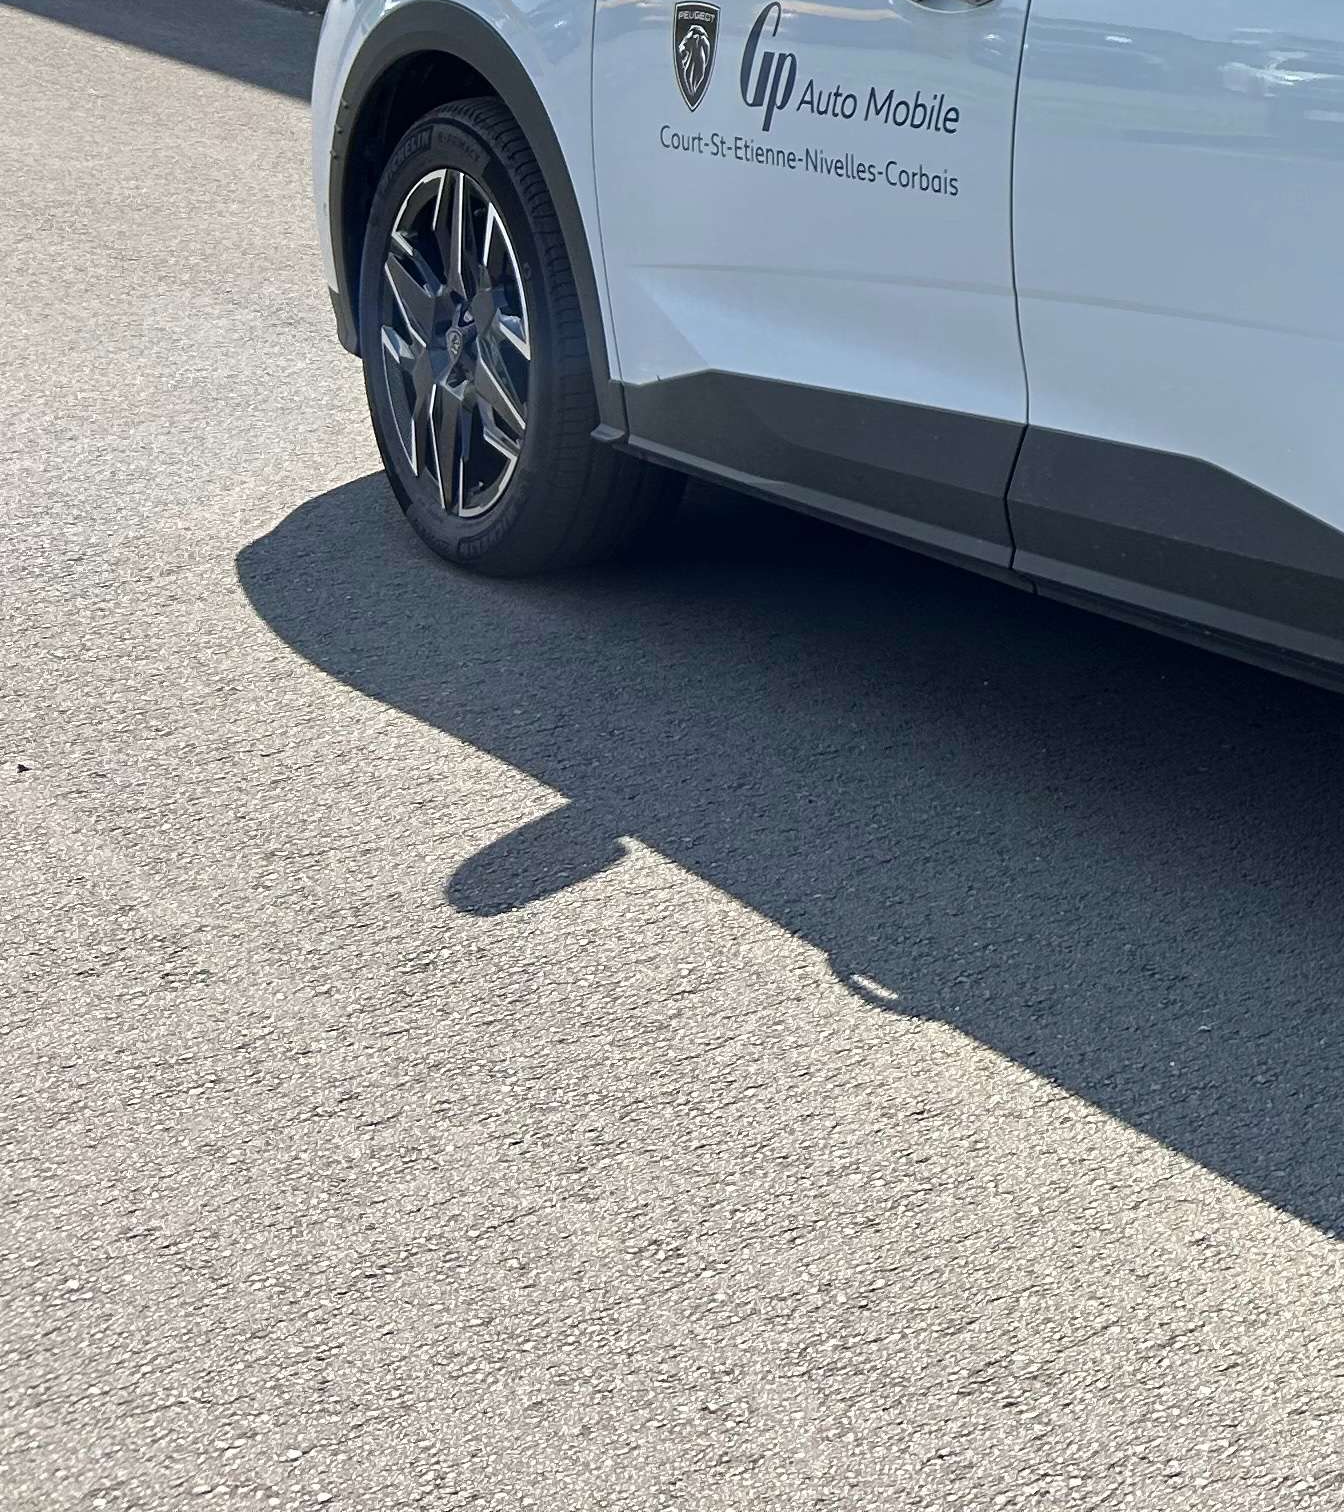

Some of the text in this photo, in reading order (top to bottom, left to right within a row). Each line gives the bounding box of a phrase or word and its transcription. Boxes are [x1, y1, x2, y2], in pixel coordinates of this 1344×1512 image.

[678, 10, 715, 22] PEUGEOT
[796, 79, 858, 120] Auto
[864, 87, 960, 136] Mobile
[660, 125, 960, 197] Court-St-Etienne-Nivelles-Corbais
